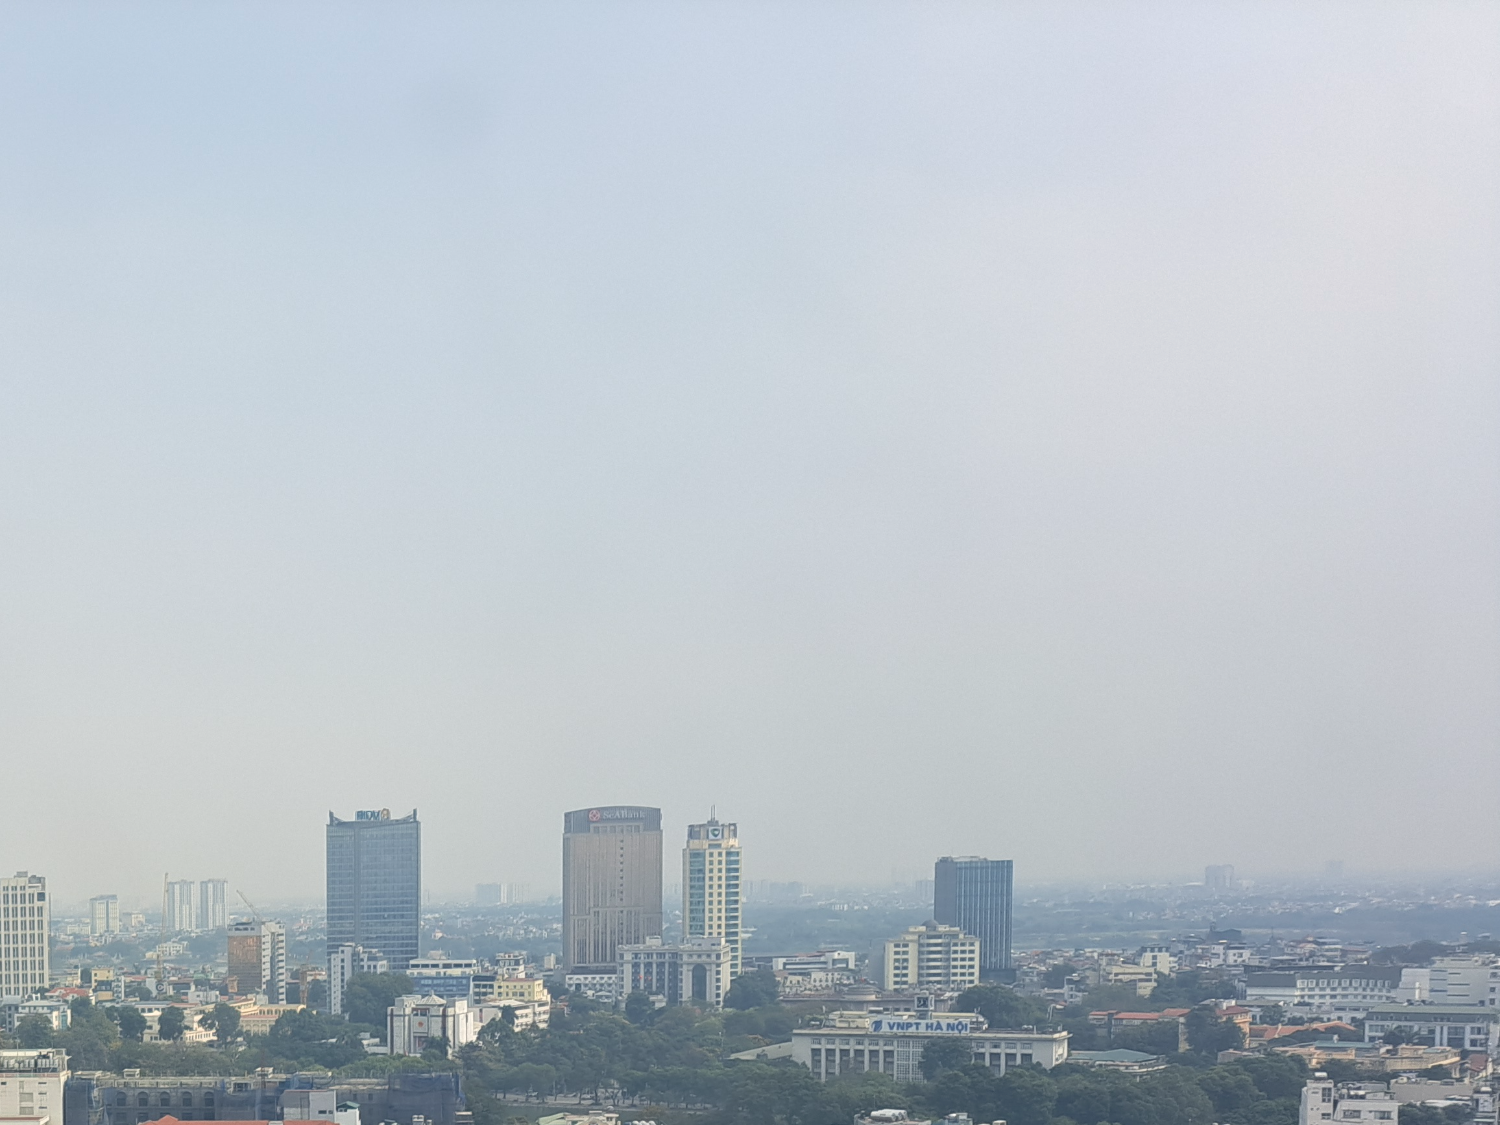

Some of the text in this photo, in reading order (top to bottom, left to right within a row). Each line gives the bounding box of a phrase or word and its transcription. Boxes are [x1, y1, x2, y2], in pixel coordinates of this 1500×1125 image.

[887, 1020, 968, 1034] VNPT HÀ NỘI
